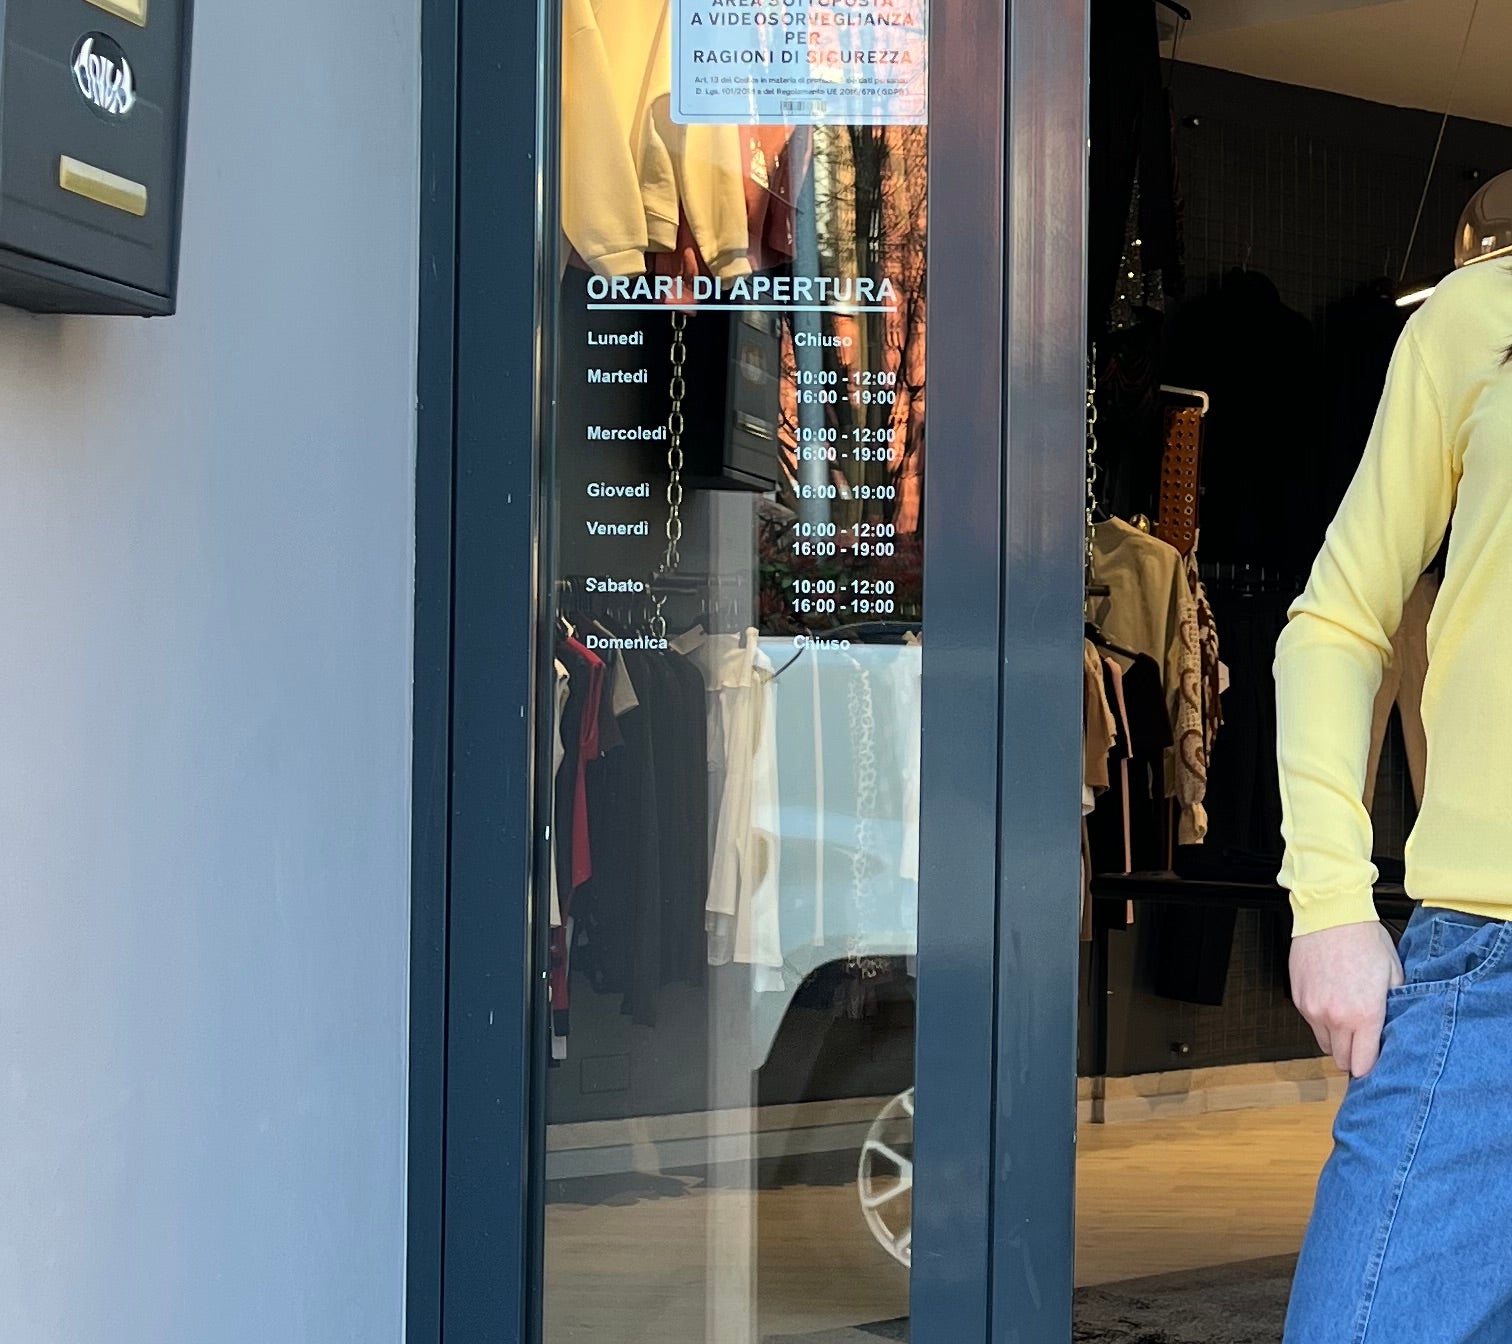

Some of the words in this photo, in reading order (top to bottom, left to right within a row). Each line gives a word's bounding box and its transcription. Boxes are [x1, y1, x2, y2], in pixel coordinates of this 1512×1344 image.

[691, 12, 702, 25] A
[709, 12, 914, 25] VIDEOSORVEGLIANZA
[785, 32, 821, 44] PER
[694, 50, 774, 63] RAGIONI
[781, 50, 799, 63] DI
[806, 50, 912, 63] SICUREZZA
[587, 276, 683, 299] ORARI
[693, 277, 721, 300] DI
[730, 277, 897, 302] APERTURA
[587, 331, 643, 345] Lunedì
[795, 332, 852, 347] Chiuso
[587, 369, 648, 383] Martedì
[796, 372, 837, 385] 10:00
[854, 372, 896, 385] 12:00
[796, 391, 837, 404] 16:00
[854, 391, 896, 404] 19:00
[587, 426, 667, 440] Mercoledì
[794, 429, 837, 442] 10:00
[853, 429, 896, 442] 12:00
[794, 448, 836, 461] 16:00
[853, 448, 896, 461] 19:00
[587, 483, 650, 497] Giovedì
[794, 486, 836, 499] 16:00
[852, 486, 895, 499] 19:00
[587, 521, 649, 535] Venerdì
[793, 524, 835, 537] 10:00
[852, 524, 895, 537] 12:00
[793, 543, 835, 556] 16:00
[852, 543, 894, 556] 19:00
[586, 579, 644, 592] Sabato
[793, 581, 835, 594] 10:00
[852, 581, 894, 594] 12:00
[793, 600, 834, 613] 16:00
[851, 600, 894, 613] 19:00
[586, 636, 668, 649] Domenica
[794, 636, 850, 650] Chiuso
